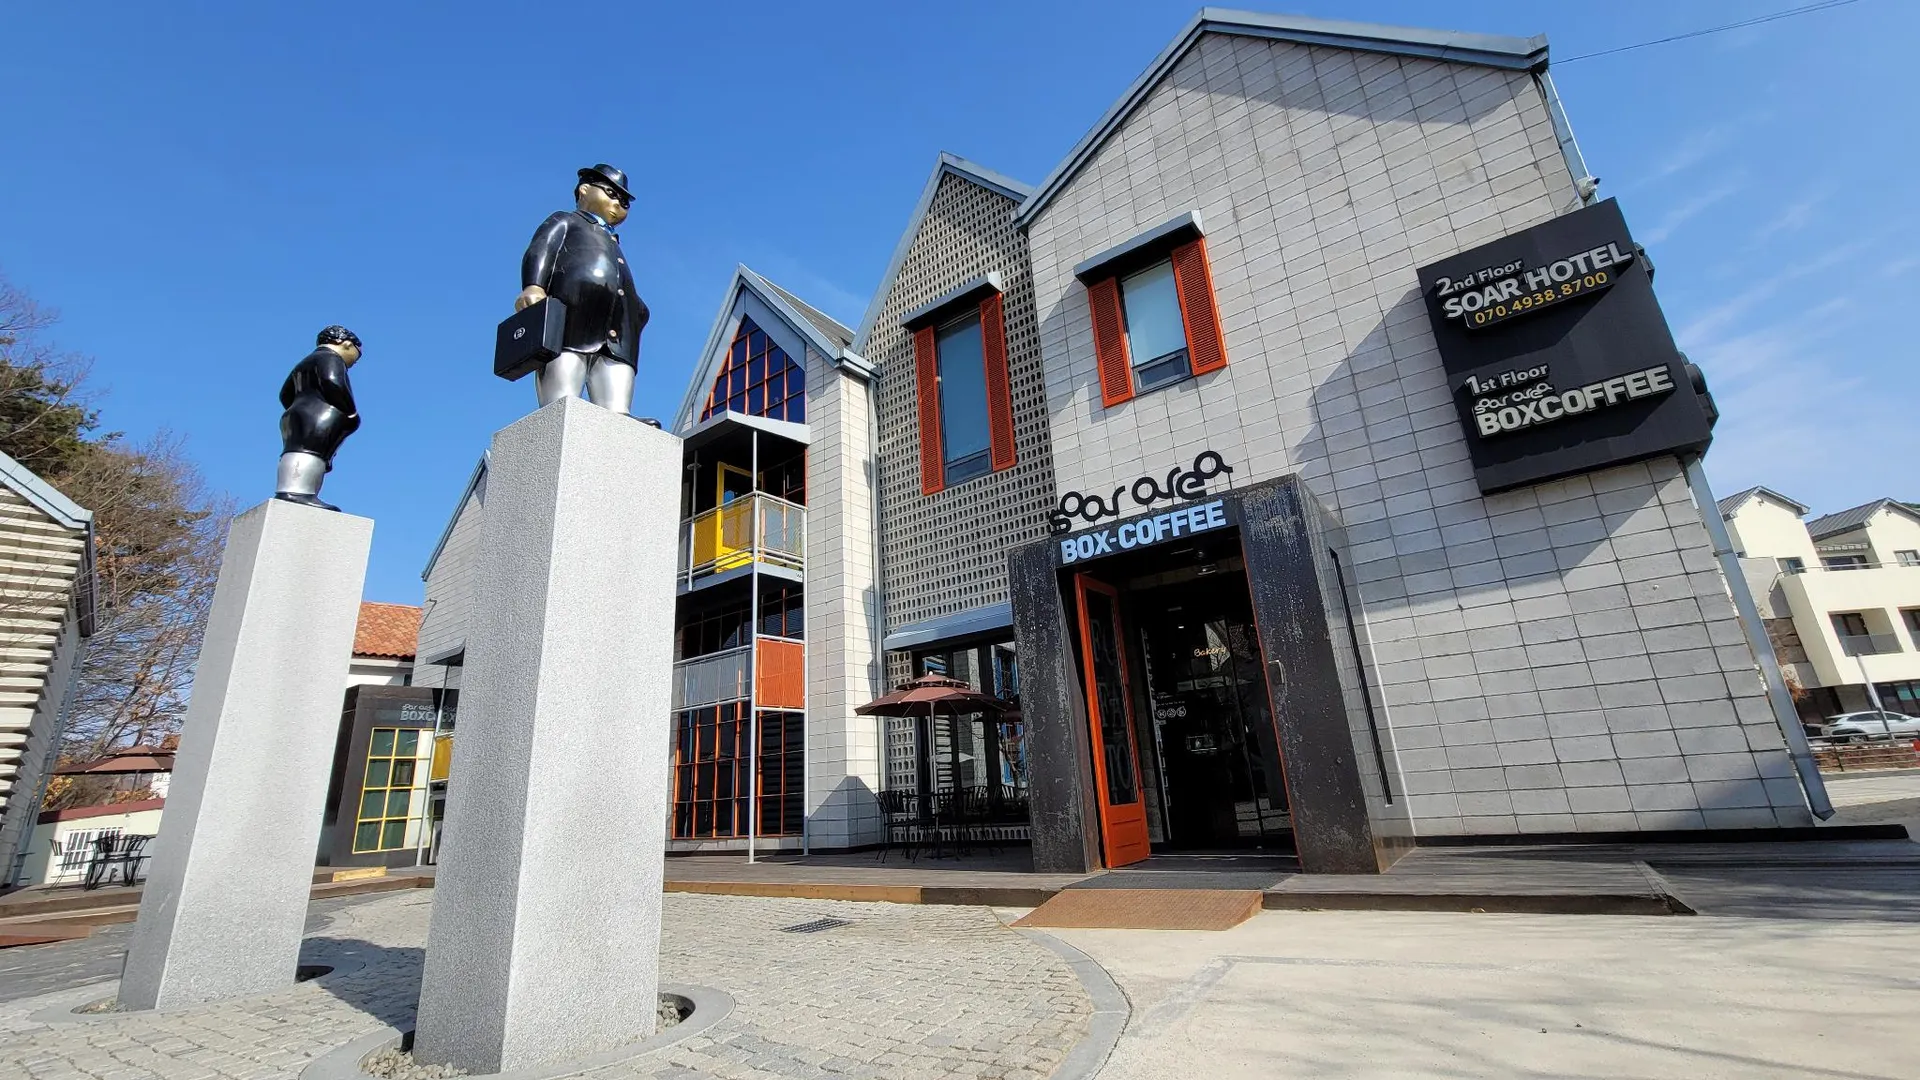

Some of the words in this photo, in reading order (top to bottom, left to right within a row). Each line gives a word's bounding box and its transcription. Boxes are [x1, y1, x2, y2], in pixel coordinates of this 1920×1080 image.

[1436, 274, 1475, 297] 2nd
[1478, 259, 1522, 284] Floor
[1443, 279, 1522, 318] SOAR
[1525, 241, 1633, 291] HOTEL
[1475, 271, 1608, 324] 070.4938.8700
[1466, 375, 1496, 395] 1st
[1501, 364, 1547, 387] Floor
[1474, 396, 1508, 415] soar
[1512, 382, 1553, 401] area
[1477, 366, 1674, 436] BOXCOFFEE
[1050, 485, 1125, 535] soar
[1132, 451, 1233, 505] area
[1061, 499, 1226, 564] BOX-COFFEE
